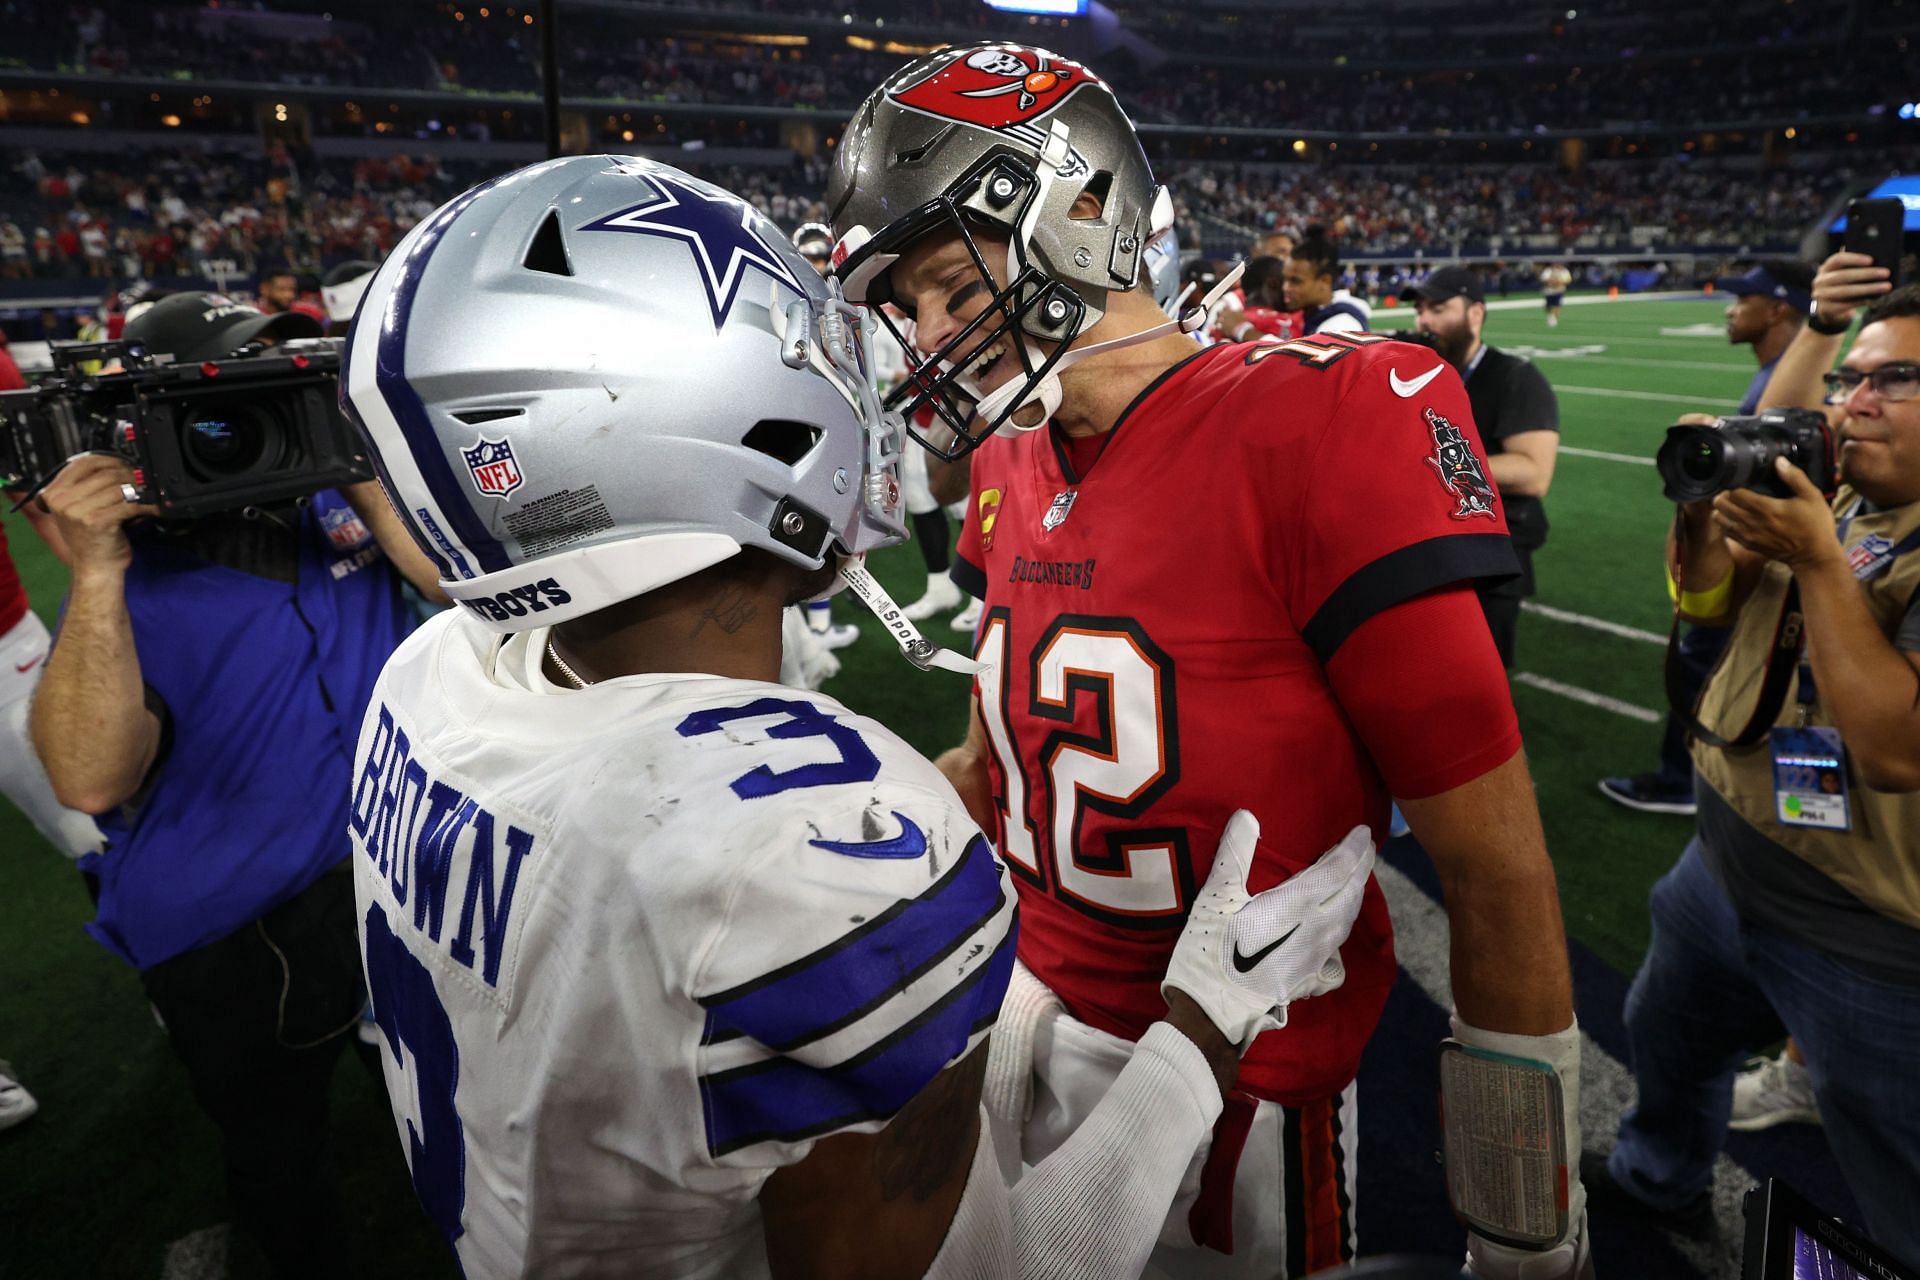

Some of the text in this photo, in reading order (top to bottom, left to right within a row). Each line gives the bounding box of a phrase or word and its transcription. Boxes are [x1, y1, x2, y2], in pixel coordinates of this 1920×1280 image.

[475, 461, 519, 492] NFL
[521, 488, 570, 509] WARNING
[419, 510, 460, 559] BROWN
[979, 488, 1001, 534] C
[1009, 555, 1096, 590] BUCCANEERS
[675, 697, 881, 801] 3
[973, 605, 1196, 932] 12
[350, 701, 535, 989] BROWN
